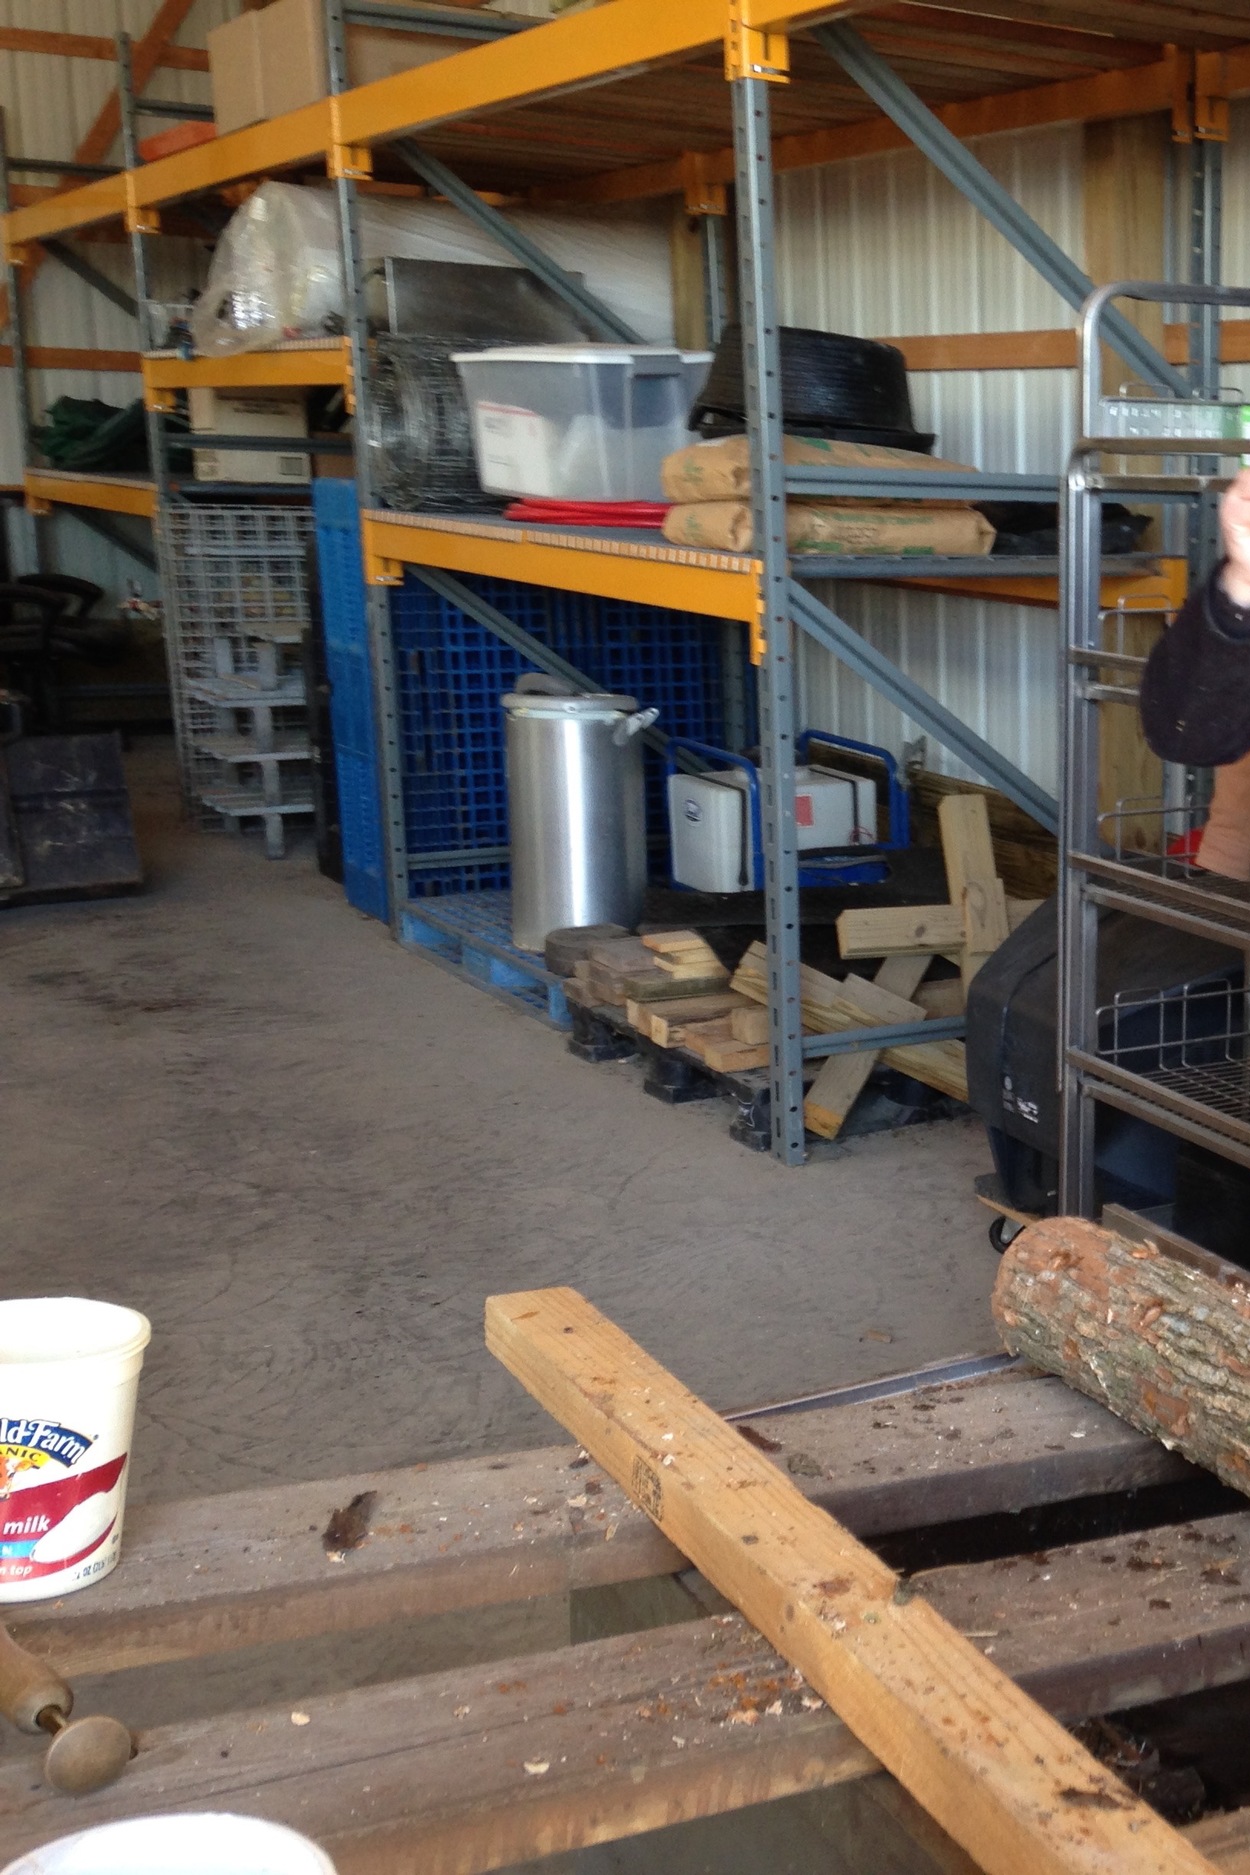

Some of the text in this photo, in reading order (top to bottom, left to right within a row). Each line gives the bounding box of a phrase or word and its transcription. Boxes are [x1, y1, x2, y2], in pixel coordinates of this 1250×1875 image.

[28, 1420, 85, 1465] Farm
[3, 1515, 50, 1535] milk
[10, 1565, 32, 1577] top
